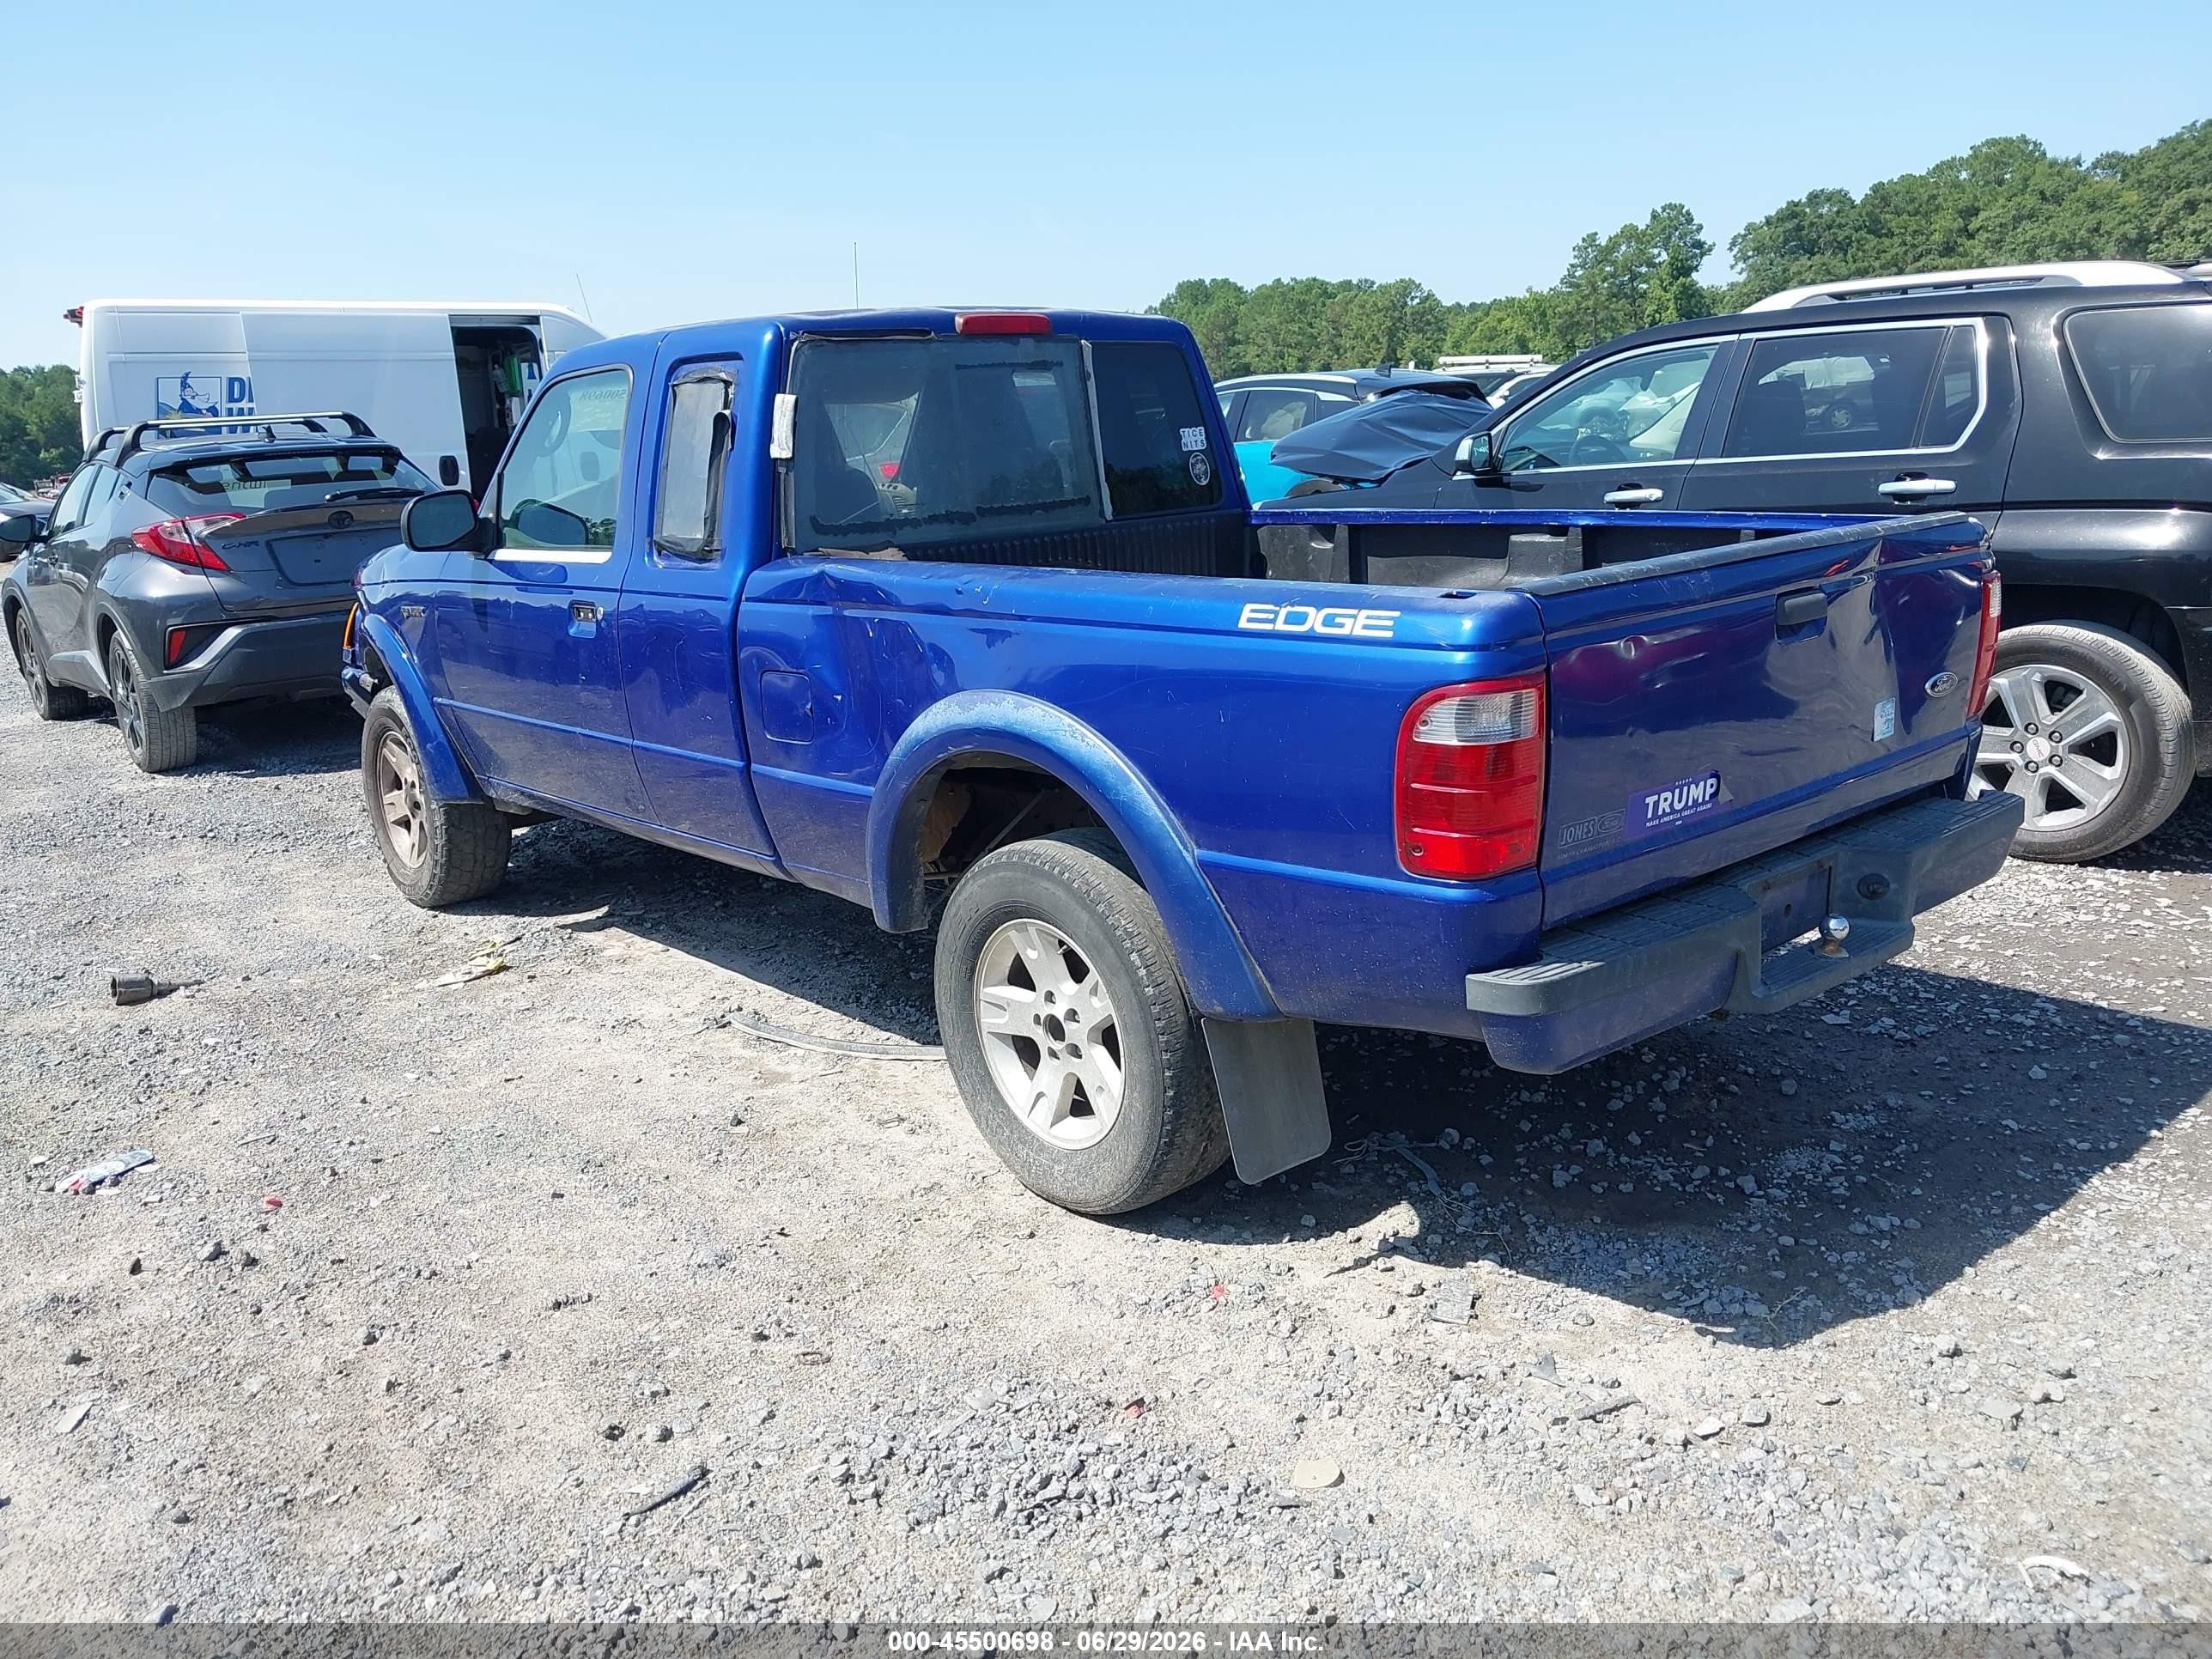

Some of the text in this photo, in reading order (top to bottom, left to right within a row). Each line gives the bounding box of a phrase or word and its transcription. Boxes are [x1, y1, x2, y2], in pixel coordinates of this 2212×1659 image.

[1237, 603, 1401, 638] EDGE
[2033, 738, 2045, 758] GMC
[1644, 777, 1717, 819] TRUMP
[1646, 819, 1659, 828] MAKE
[1660, 812, 1680, 823] AMERICA
[1681, 808, 1696, 817] GREAT
[1561, 820, 1595, 846] JONES
